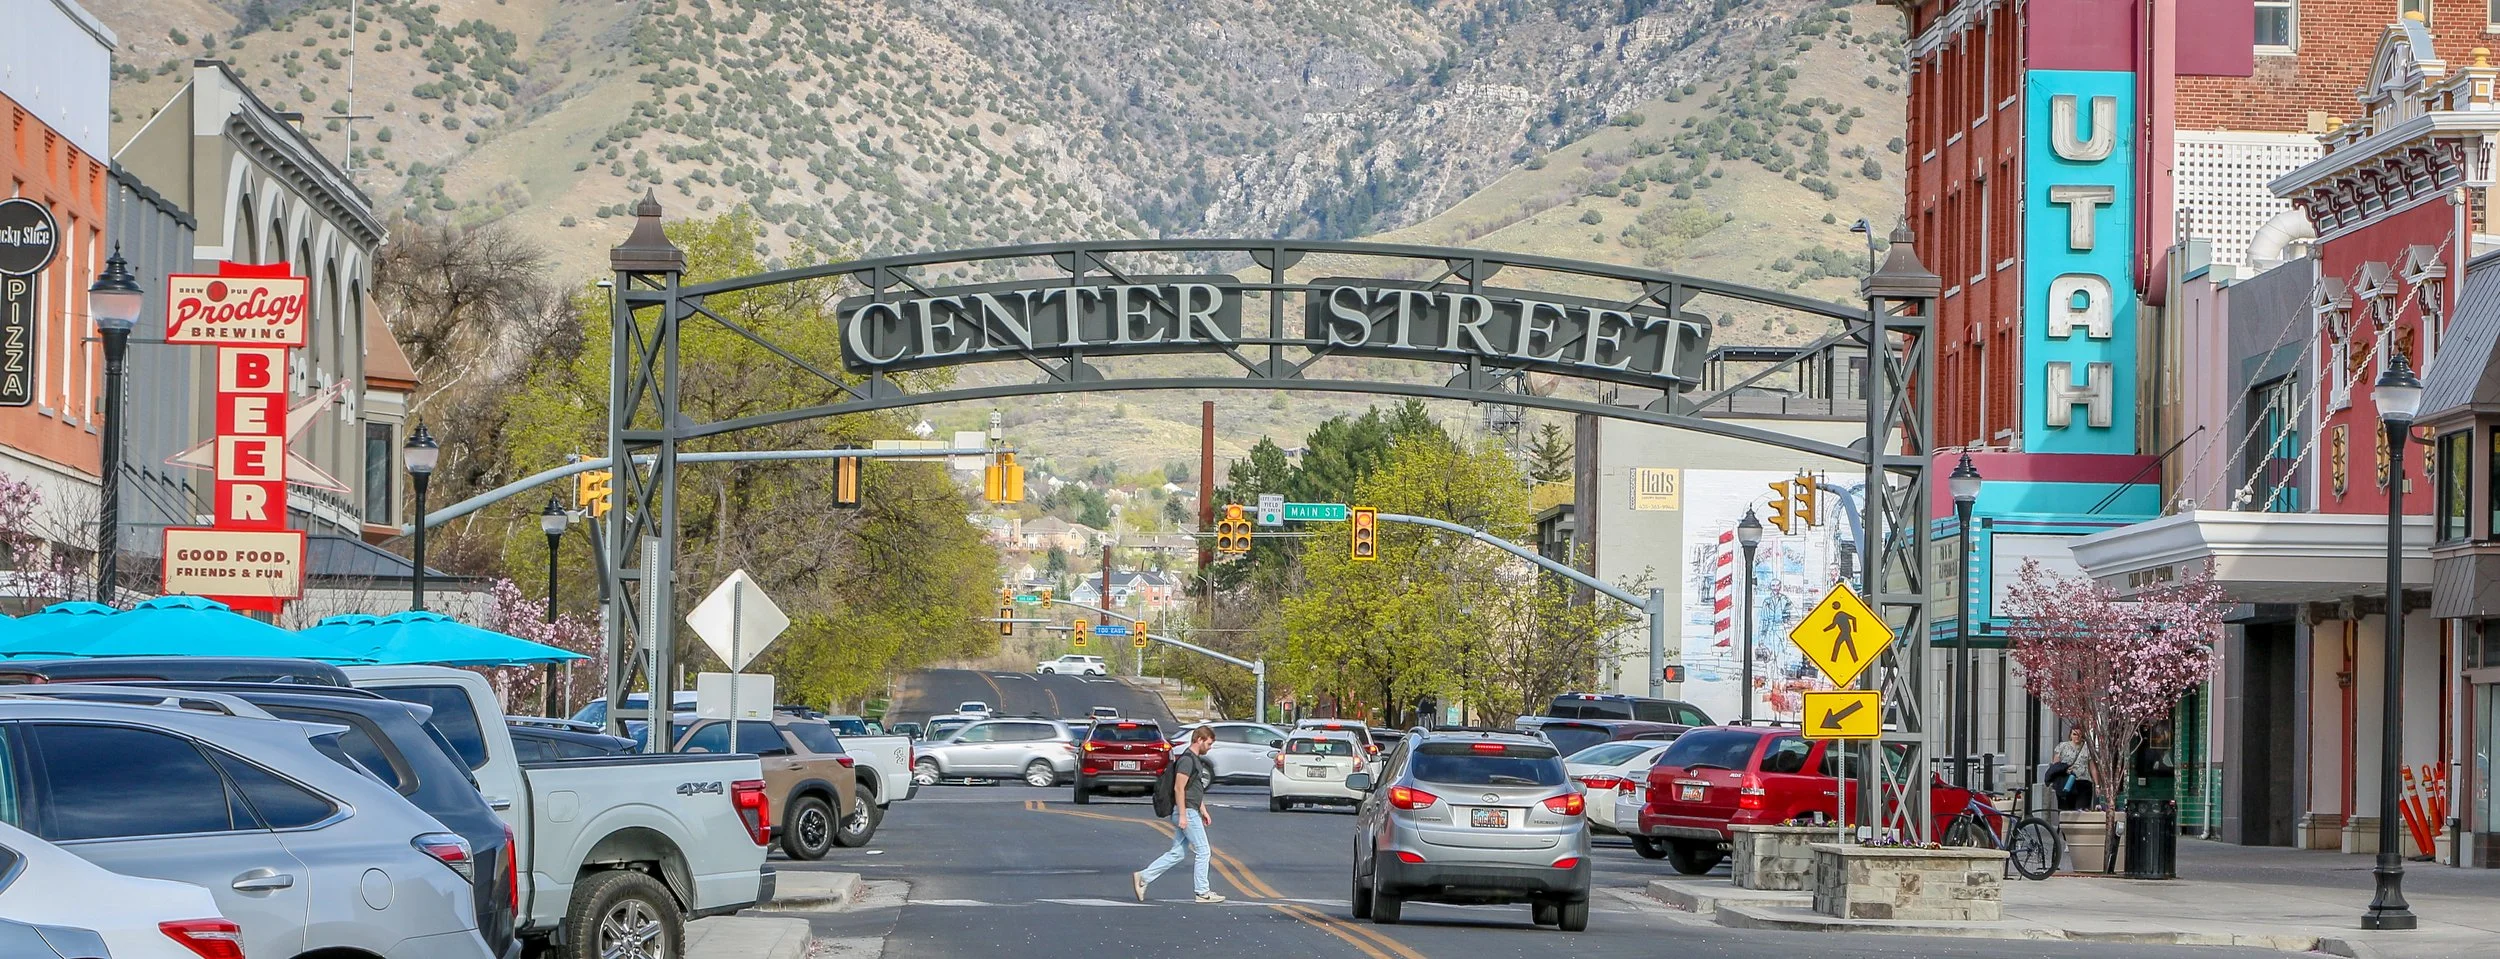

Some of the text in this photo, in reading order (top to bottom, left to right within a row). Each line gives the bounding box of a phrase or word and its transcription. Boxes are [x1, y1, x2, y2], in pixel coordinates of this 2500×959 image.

[23, 225, 50, 245] Slice
[2046, 94, 2117, 429] UTAH
[166, 286, 306, 338] Prodigy
[3, 278, 26, 396] PIZZA
[191, 327, 286, 339] BREWING
[847, 283, 1703, 380] CENTER STREET
[231, 352, 271, 521] BEER
[1641, 469, 1674, 493] flats
[1291, 507, 1339, 517] MAIN ST.
[177, 549, 291, 565] GOOD FOOD,
[176, 567, 283, 579] FRIENDS & FUN
